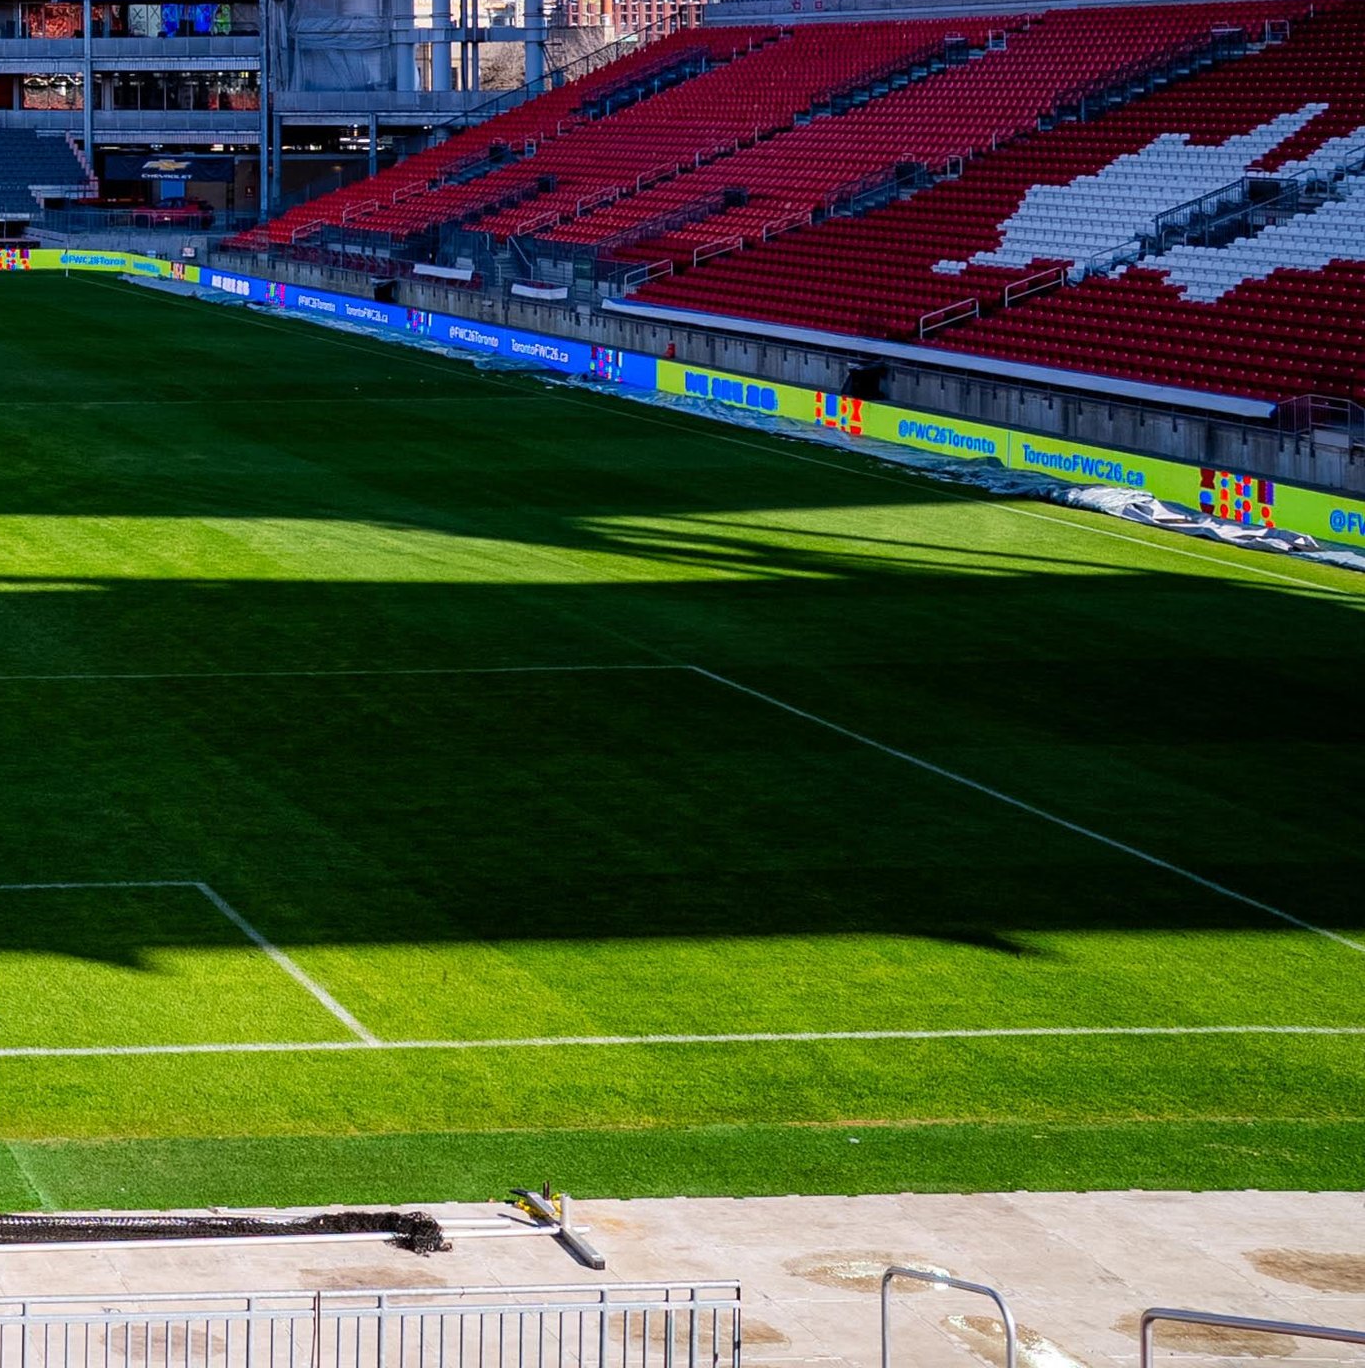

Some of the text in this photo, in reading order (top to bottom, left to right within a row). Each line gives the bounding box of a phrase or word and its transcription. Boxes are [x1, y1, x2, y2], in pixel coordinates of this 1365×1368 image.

[449, 326, 499, 347] @FWC26Toronto
[511, 338, 569, 363] TorontoFWC26.ca
[685, 371, 778, 411] WE ARE 26
[898, 419, 996, 455] @FWC26Toronto
[1022, 443, 1145, 487] TorontoFWC26.ca
